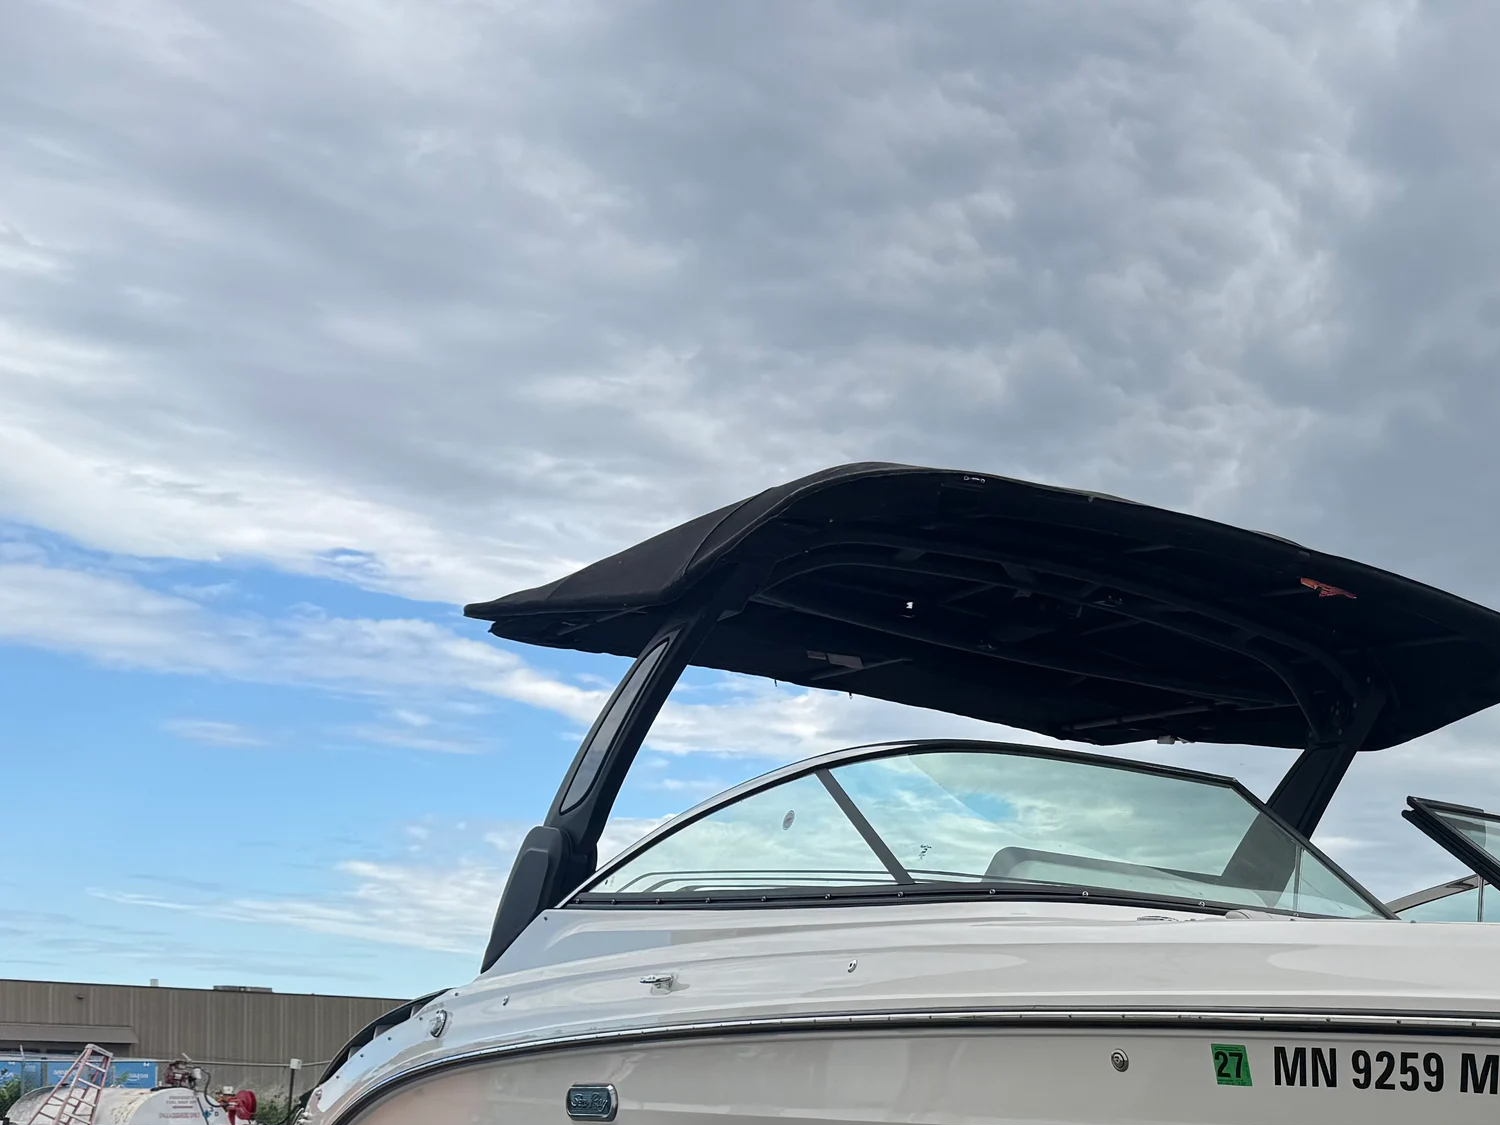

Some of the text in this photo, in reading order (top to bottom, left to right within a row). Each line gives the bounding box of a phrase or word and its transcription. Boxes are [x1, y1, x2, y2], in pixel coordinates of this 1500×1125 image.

[1214, 1050, 1243, 1079] 27
[1273, 1046, 1338, 1088] MN
[1351, 1049, 1445, 1093] 9259
